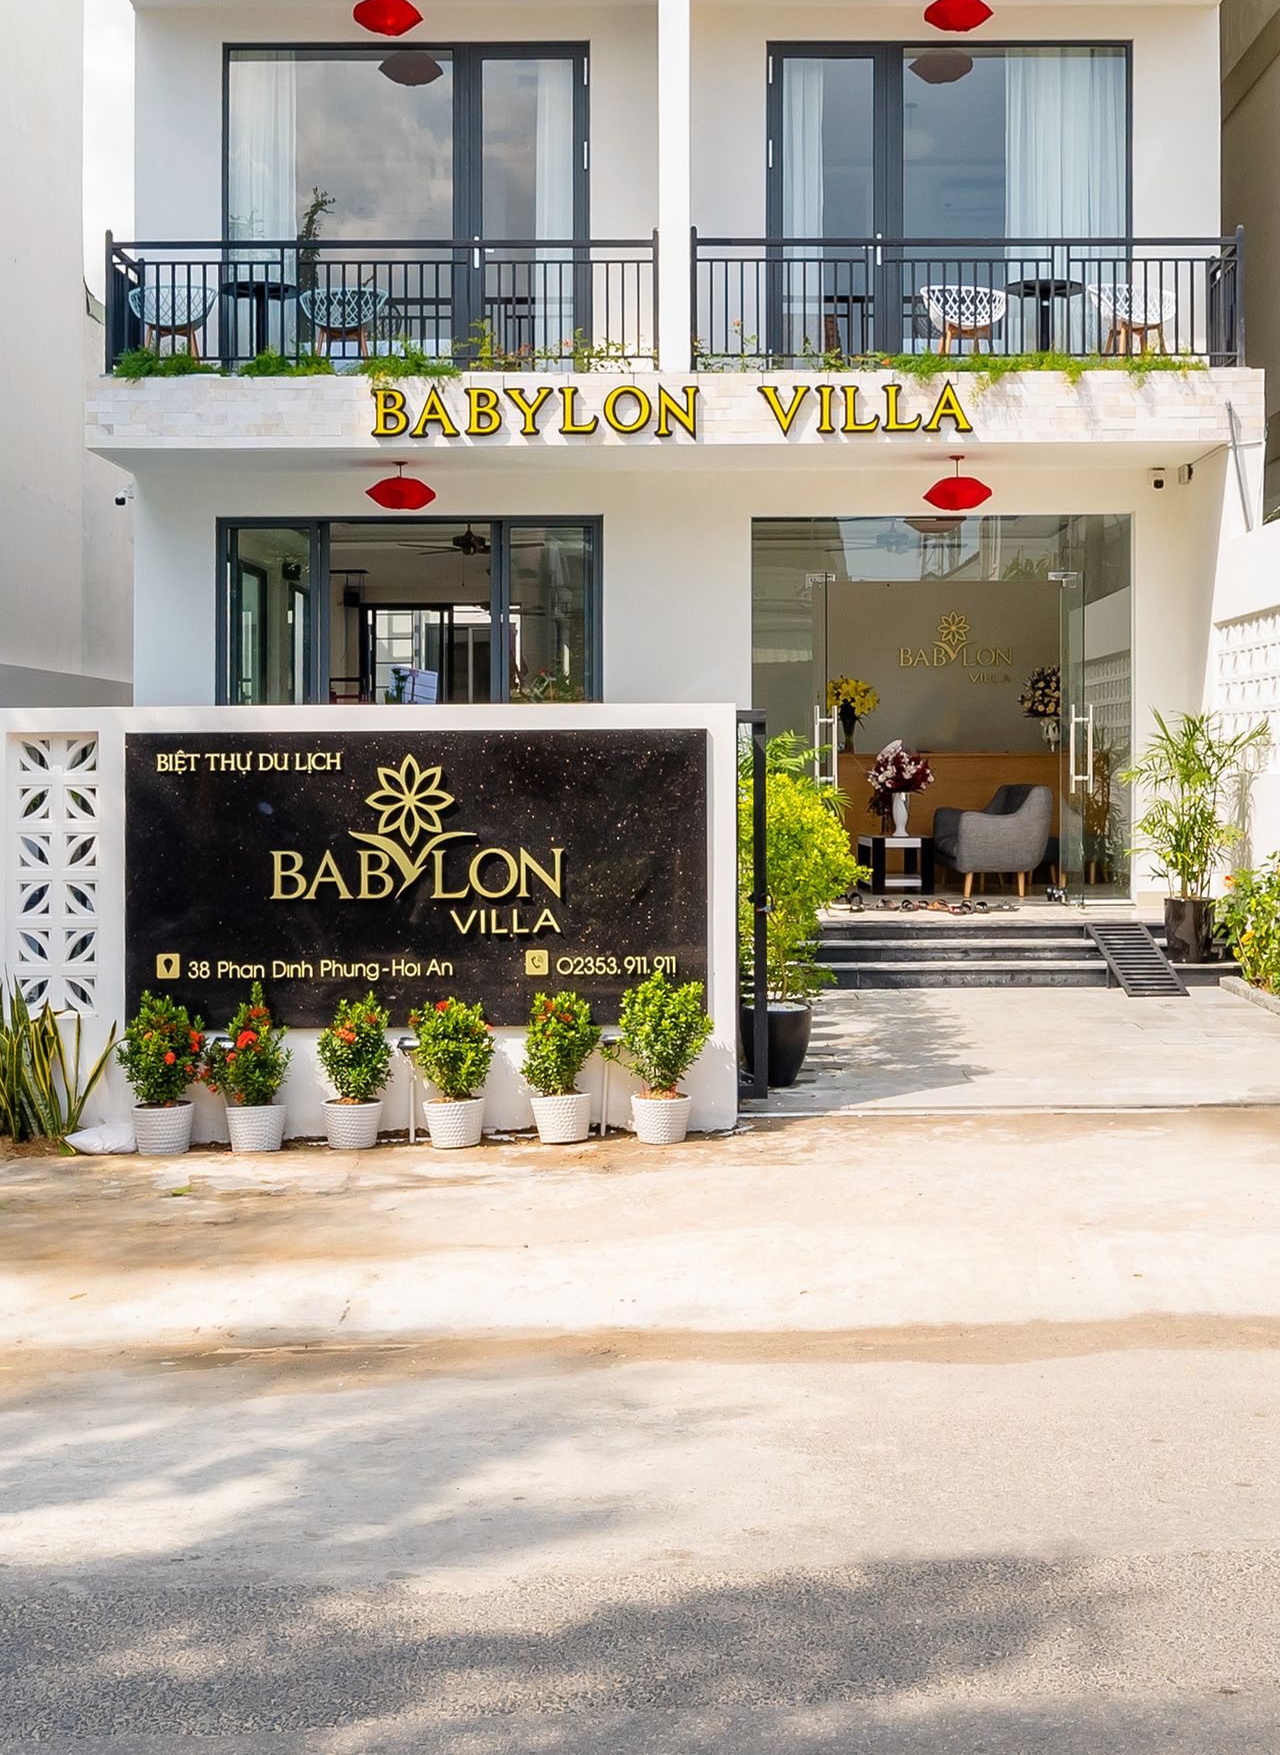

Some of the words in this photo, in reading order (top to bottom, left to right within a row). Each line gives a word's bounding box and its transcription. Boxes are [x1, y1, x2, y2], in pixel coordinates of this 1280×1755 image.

[370, 383, 700, 440] BABYLON
[756, 379, 974, 436] VILLA
[899, 641, 1013, 667] BABYLON
[968, 672, 1011, 684] VILLA
[156, 749, 201, 775] BIỆT
[204, 750, 253, 775] THỰ
[258, 753, 289, 772] DU
[295, 751, 342, 774] LỊCH
[269, 831, 565, 900] BABYLON
[450, 908, 562, 934] VILLA
[187, 960, 211, 979] 38
[217, 960, 266, 979] Phan
[426, 958, 454, 976] An
